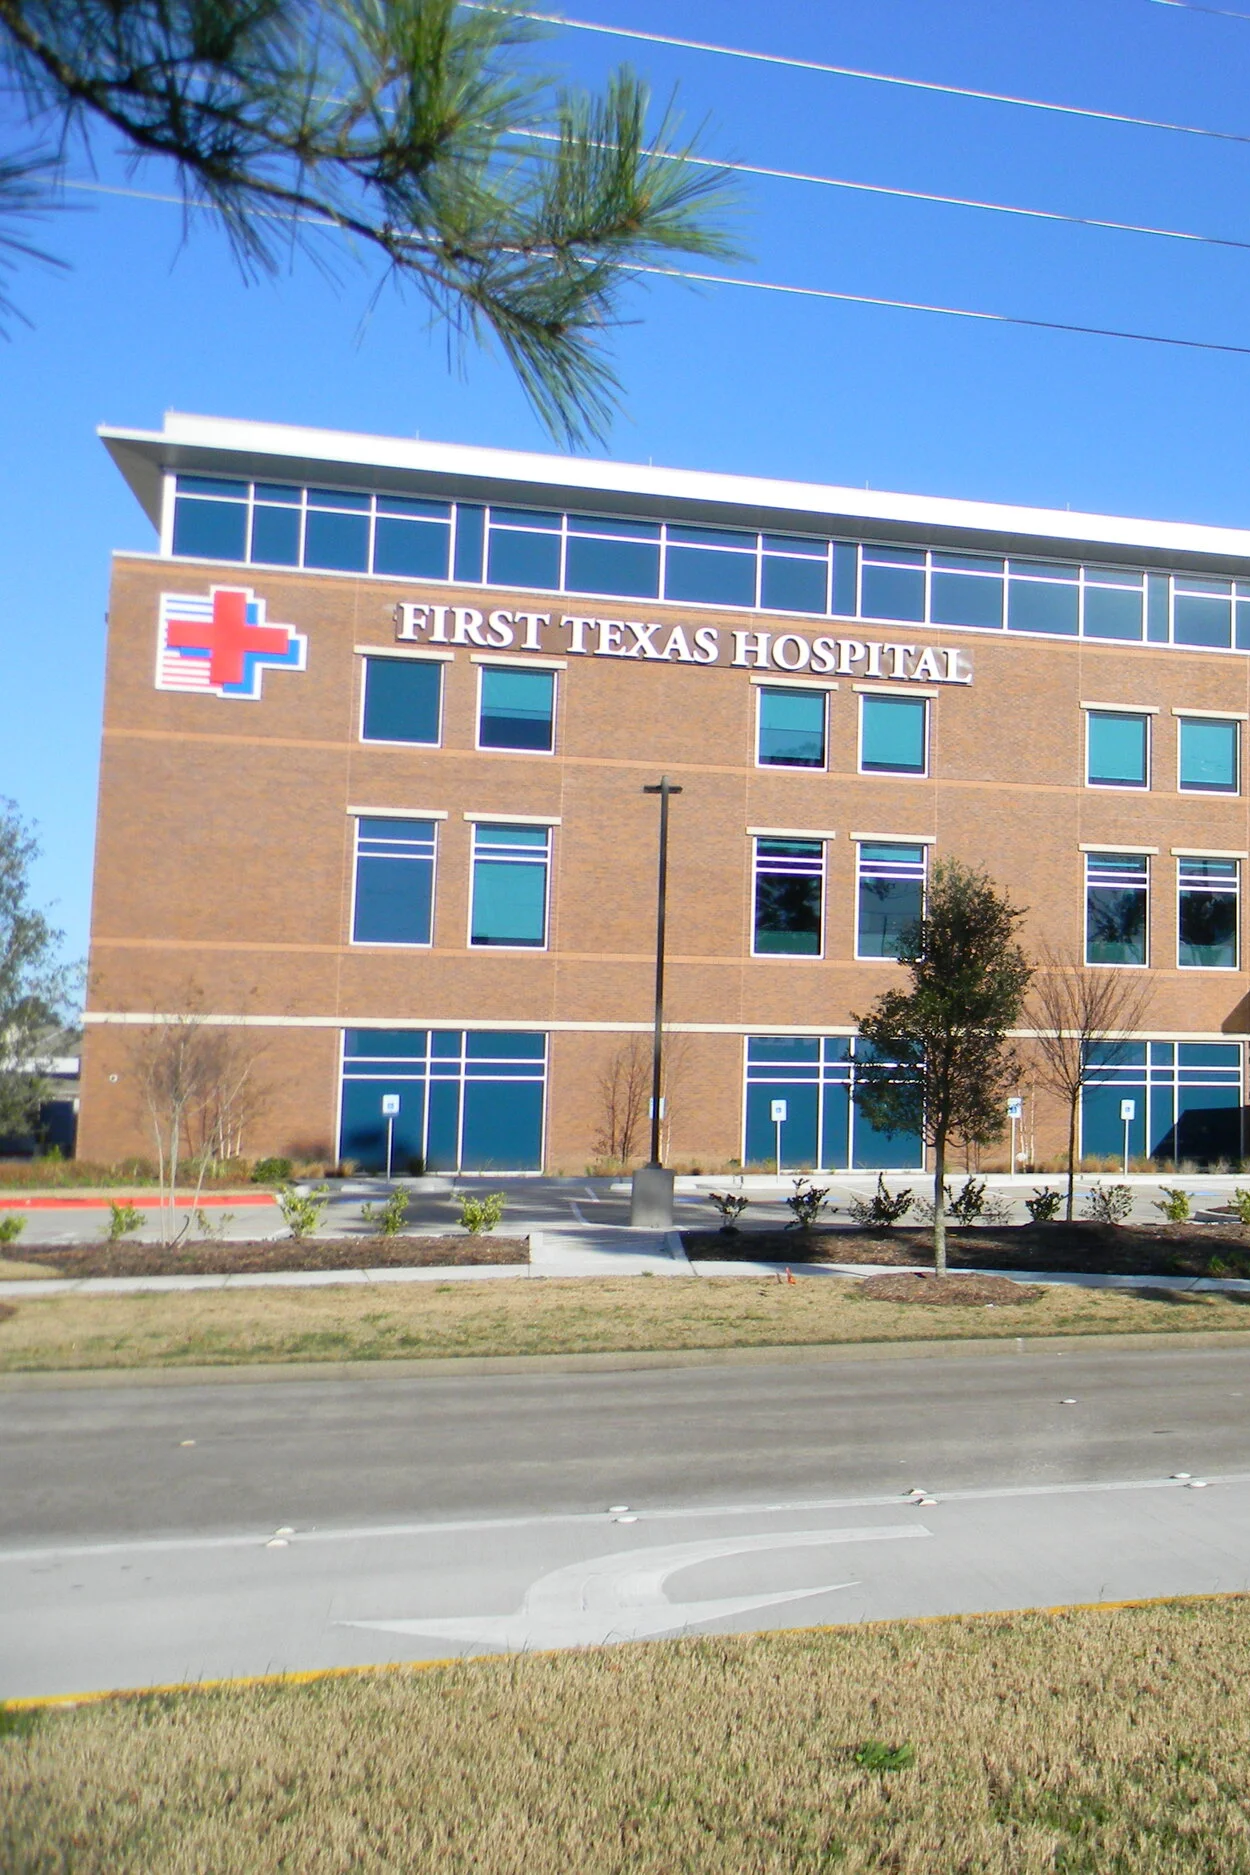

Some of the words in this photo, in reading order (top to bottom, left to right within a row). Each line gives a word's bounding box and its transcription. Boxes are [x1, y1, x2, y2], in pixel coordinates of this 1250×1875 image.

[397, 602, 550, 649] FIRST
[559, 615, 719, 665] TEXAS
[731, 631, 973, 684] HOSPITAL
